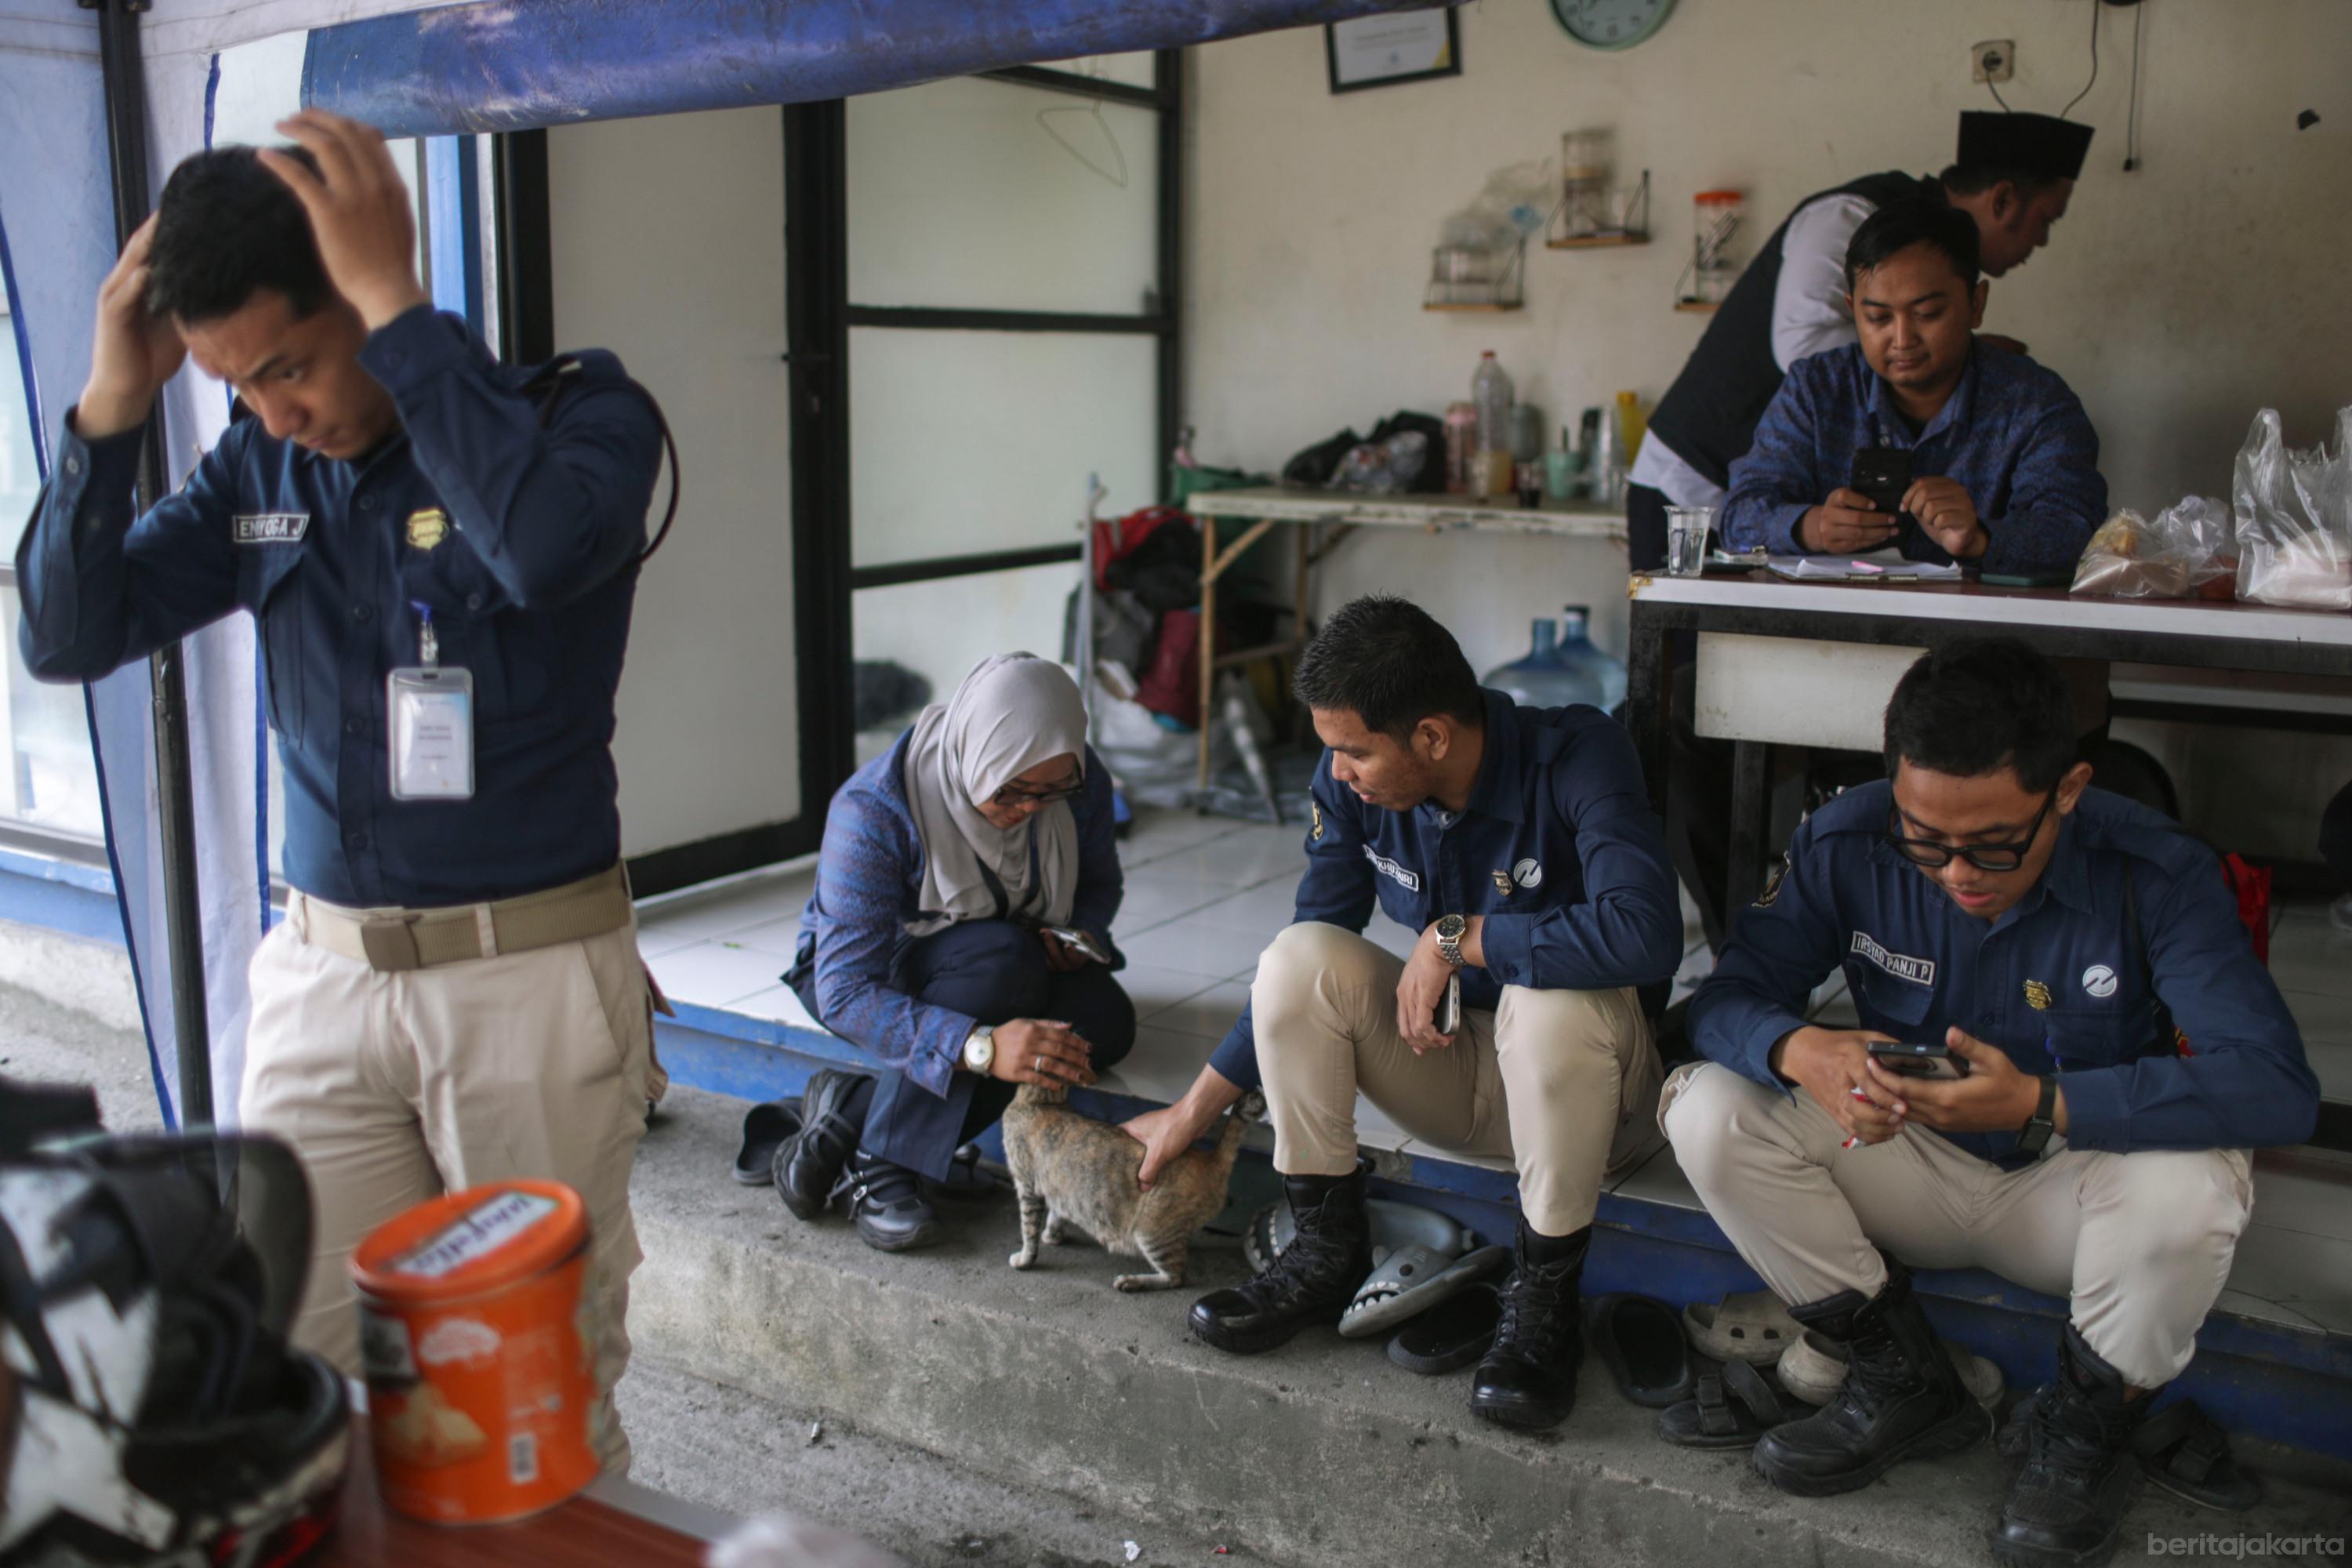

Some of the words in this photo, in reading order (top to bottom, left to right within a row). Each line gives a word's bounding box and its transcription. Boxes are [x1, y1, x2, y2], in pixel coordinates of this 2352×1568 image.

[1857, 936, 1885, 964] IRSYAD
[1886, 956, 1917, 978] PANJI
[1920, 964, 1929, 979] P
